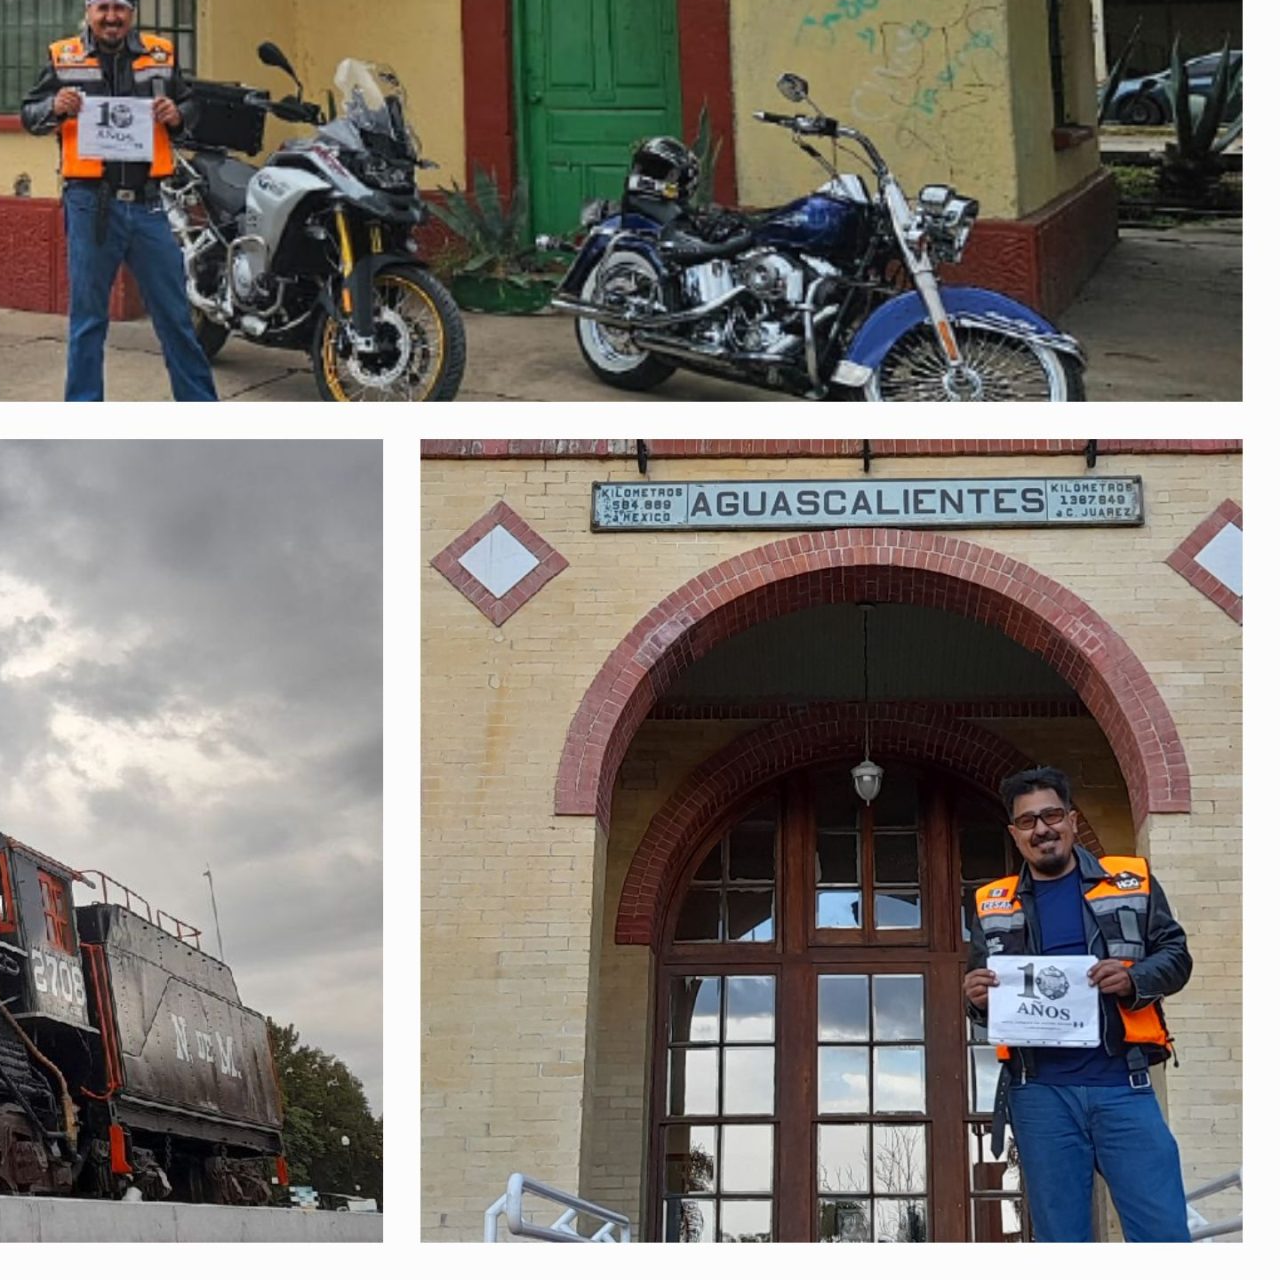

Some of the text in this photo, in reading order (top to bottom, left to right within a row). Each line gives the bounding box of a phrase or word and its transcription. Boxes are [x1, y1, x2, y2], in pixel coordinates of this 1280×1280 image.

[602, 488, 683, 498] KILOMETROS
[1051, 483, 1133, 493] KILOMETROS
[690, 487, 1046, 518] AGUASCALIENTES
[623, 512, 671, 522] MEXICO
[1081, 507, 1131, 517] JUAREZ
[31, 948, 87, 1006] 2708
[1017, 1001, 1071, 1021] AÑOS
